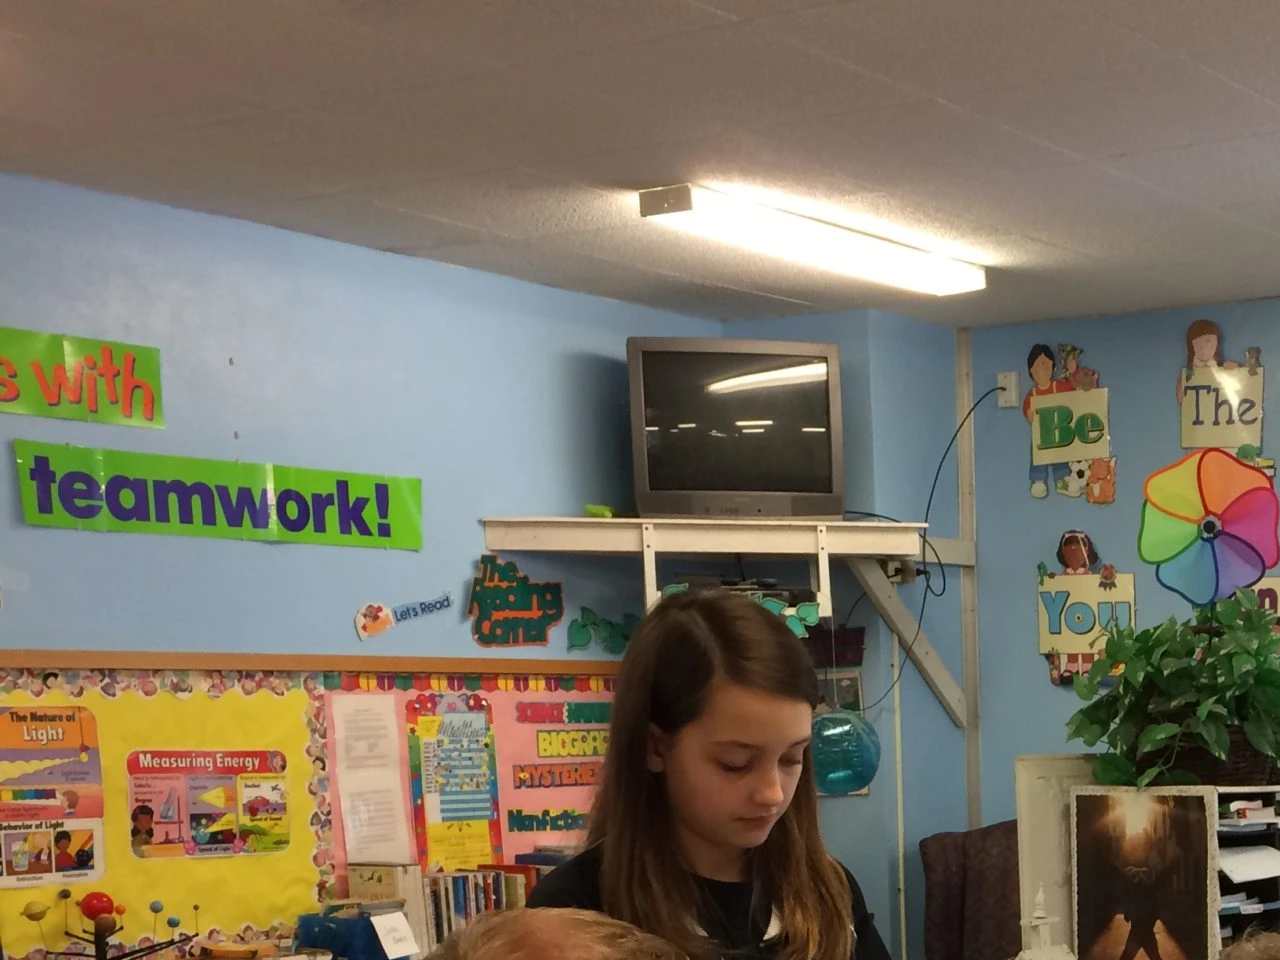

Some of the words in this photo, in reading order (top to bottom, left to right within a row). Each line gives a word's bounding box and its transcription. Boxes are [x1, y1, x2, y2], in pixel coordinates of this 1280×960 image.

[31, 345, 155, 422] with
[1184, 383, 1261, 428] The
[1036, 406, 1105, 450] Be
[29, 455, 392, 538] teamwork!
[394, 605, 419, 623] Let's
[420, 596, 451, 615] Read
[1038, 589, 1133, 637] You
[9, 711, 28, 723] The
[30, 711, 63, 723] Nature
[65, 711, 76, 723] of
[23, 726, 65, 745] Light
[138, 753, 214, 771] Measuring
[216, 754, 261, 771] Energy
[45, 820, 65, 831] Light
